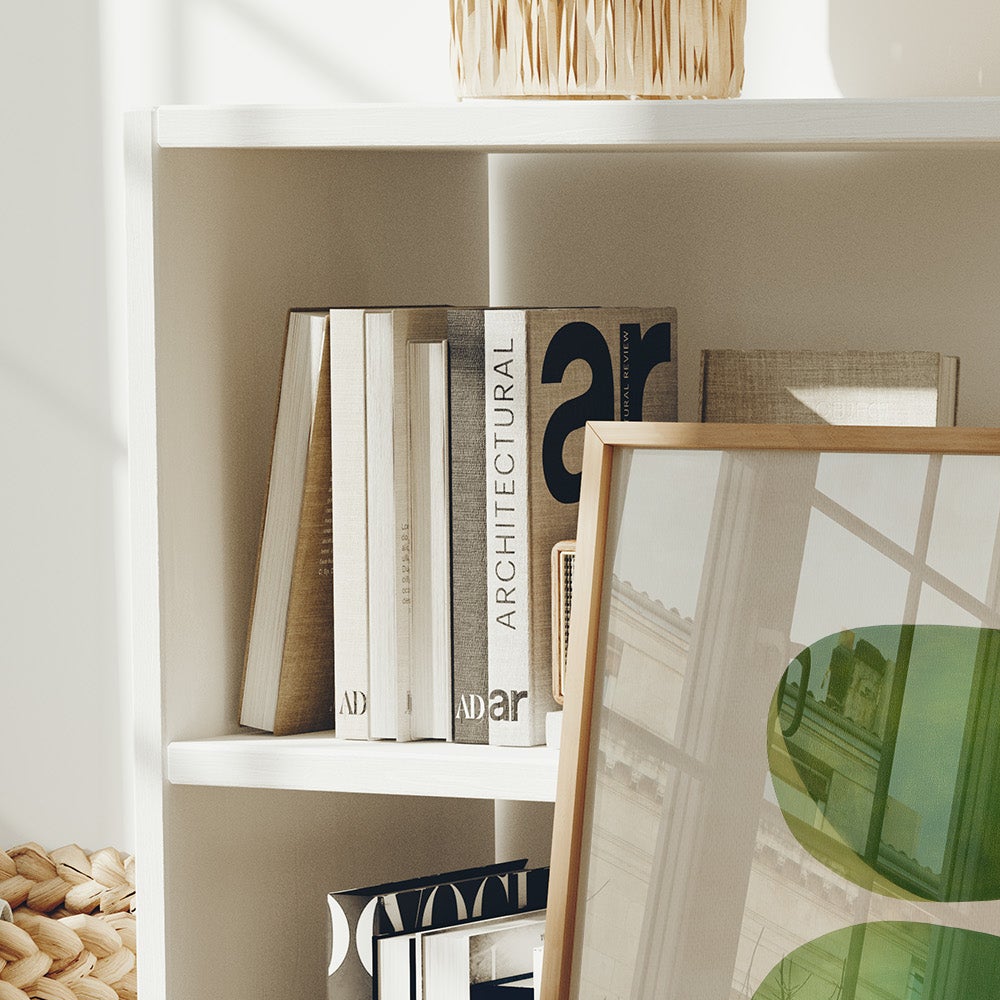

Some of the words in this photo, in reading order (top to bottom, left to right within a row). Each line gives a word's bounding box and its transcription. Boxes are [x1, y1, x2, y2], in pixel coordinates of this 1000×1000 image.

[622, 330, 630, 380] REVIEW
[493, 338, 516, 631] ARCHITECTURAL
[339, 690, 367, 716] AD
[455, 694, 485, 720] AD
[489, 689, 528, 721] ar
